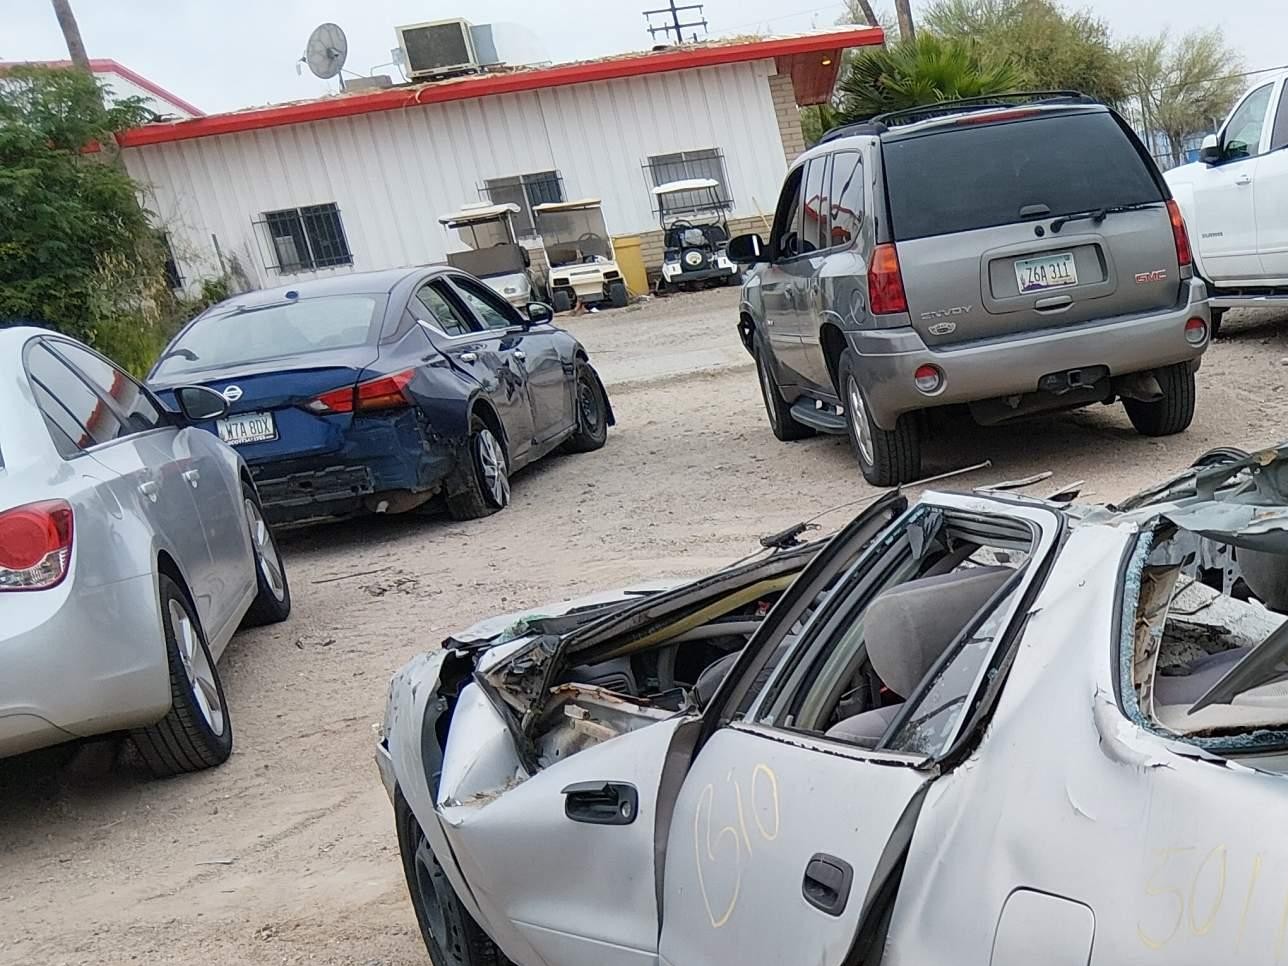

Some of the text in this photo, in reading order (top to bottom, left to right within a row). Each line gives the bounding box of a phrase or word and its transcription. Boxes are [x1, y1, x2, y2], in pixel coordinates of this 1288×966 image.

[1025, 264, 1047, 283] Z6A
[1135, 269, 1167, 283] GMC
[920, 305, 972, 320] ENVOY
